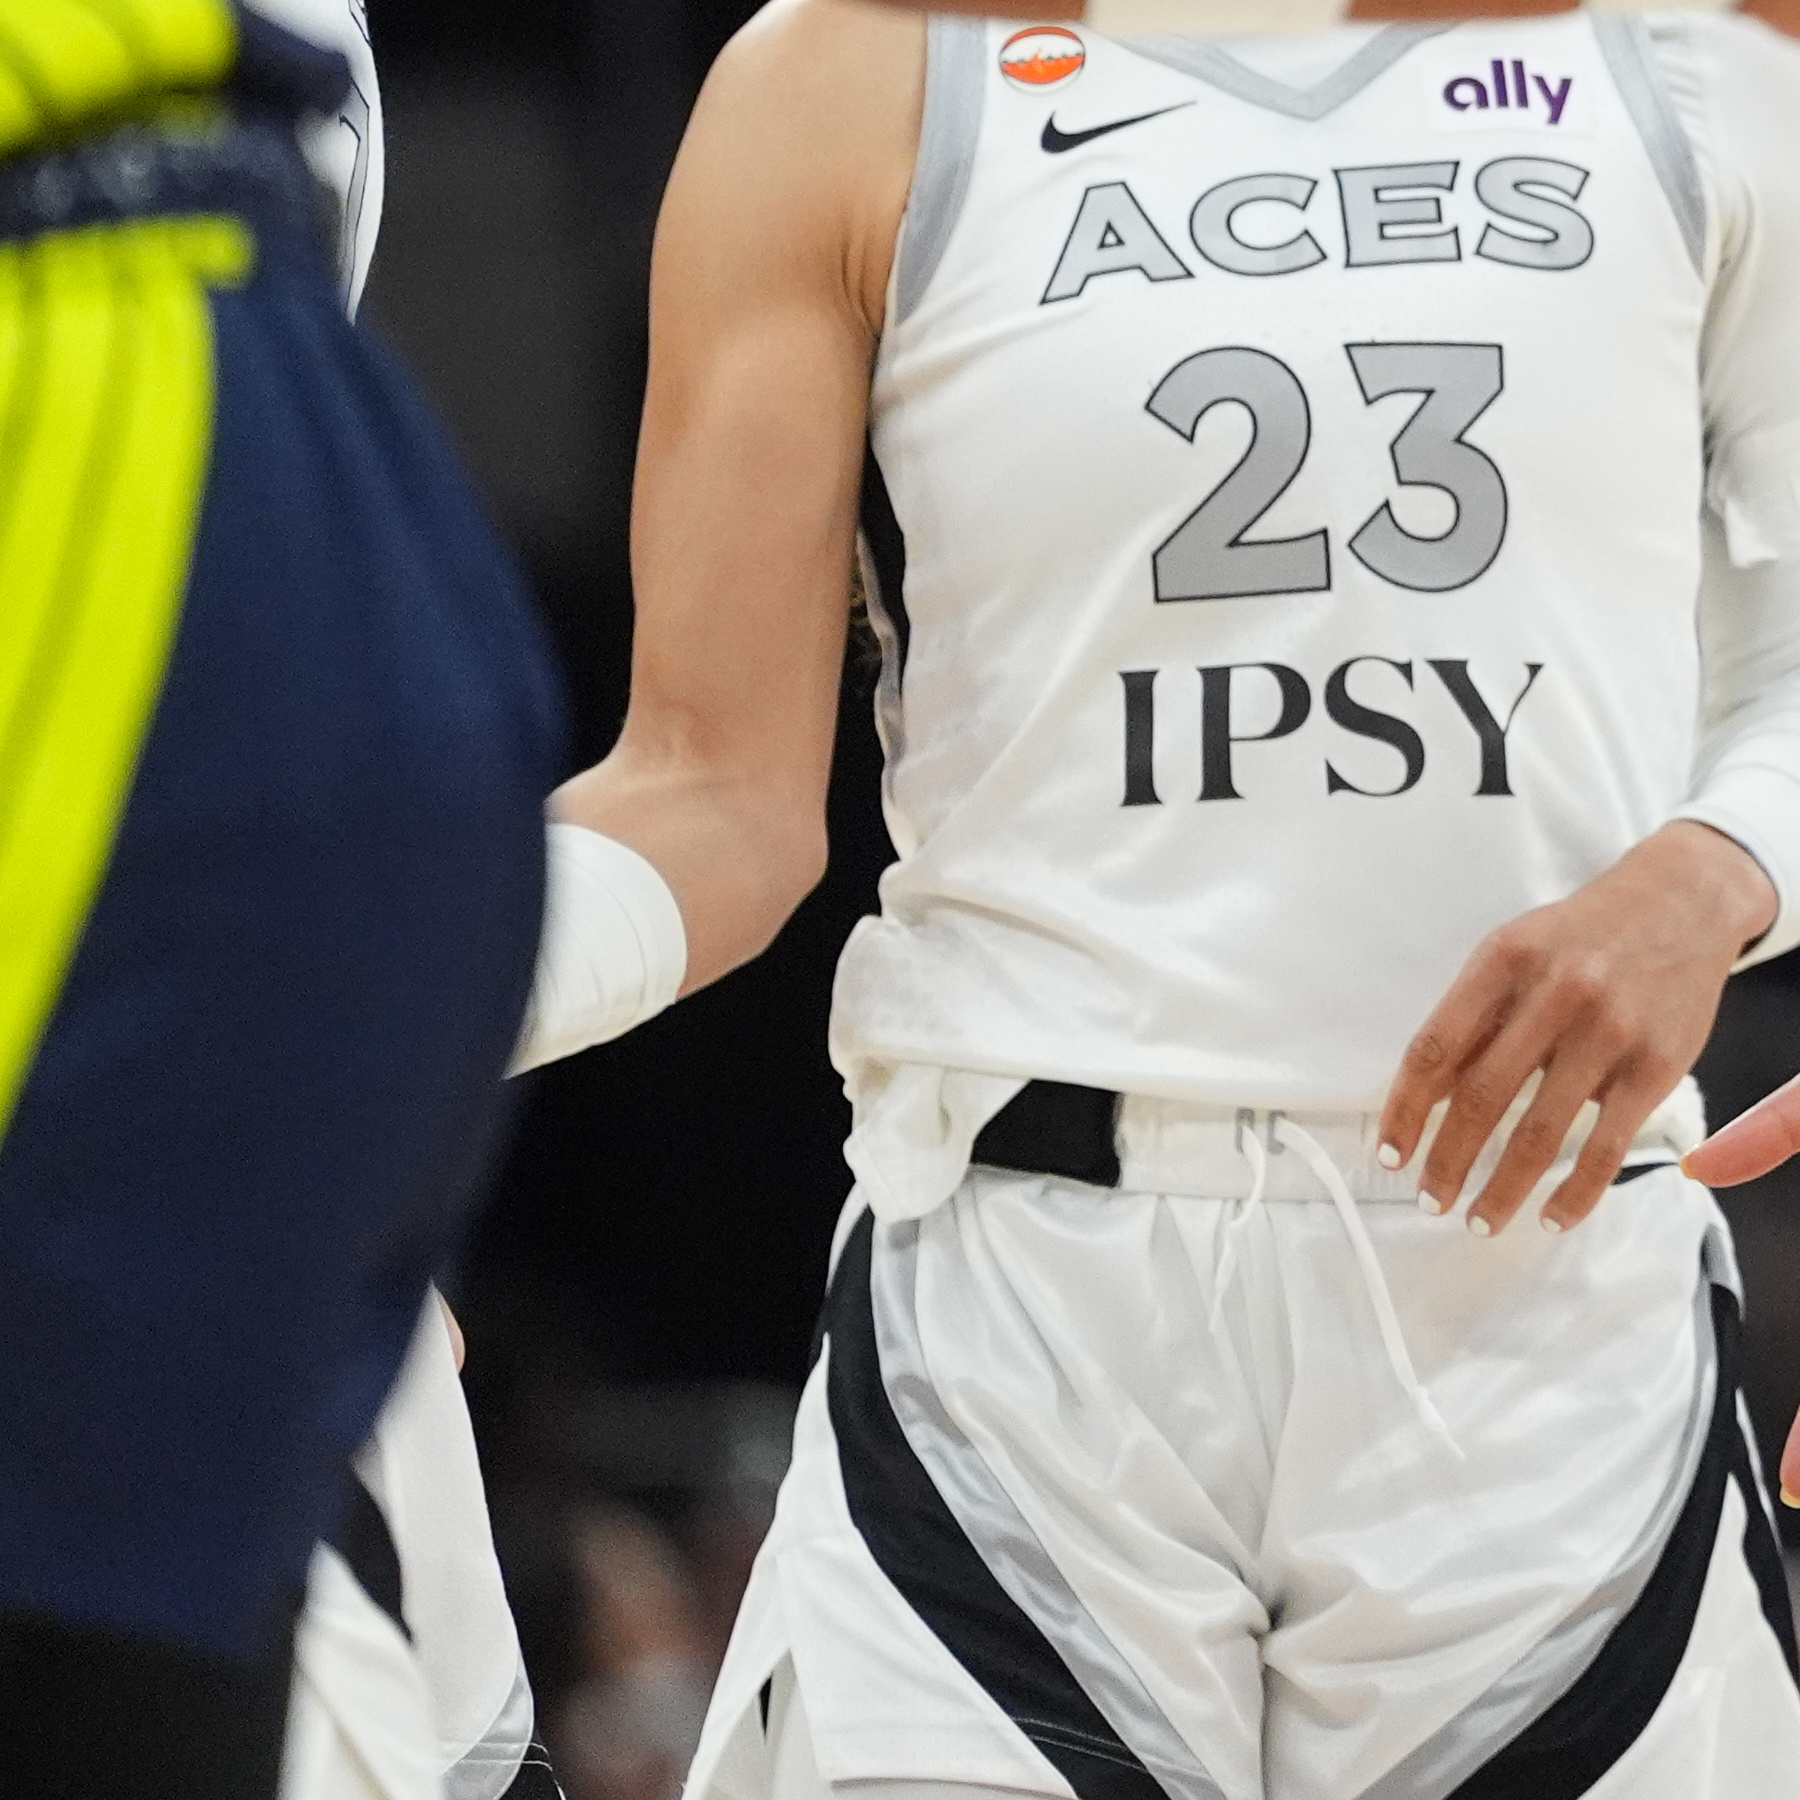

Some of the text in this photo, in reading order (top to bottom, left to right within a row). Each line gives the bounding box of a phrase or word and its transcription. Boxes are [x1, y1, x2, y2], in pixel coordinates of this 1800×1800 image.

[1442, 59, 1573, 126] ally
[1039, 156, 1595, 306] ACES
[1144, 341, 1509, 604] 23
[1118, 655, 1545, 808] IPSY
